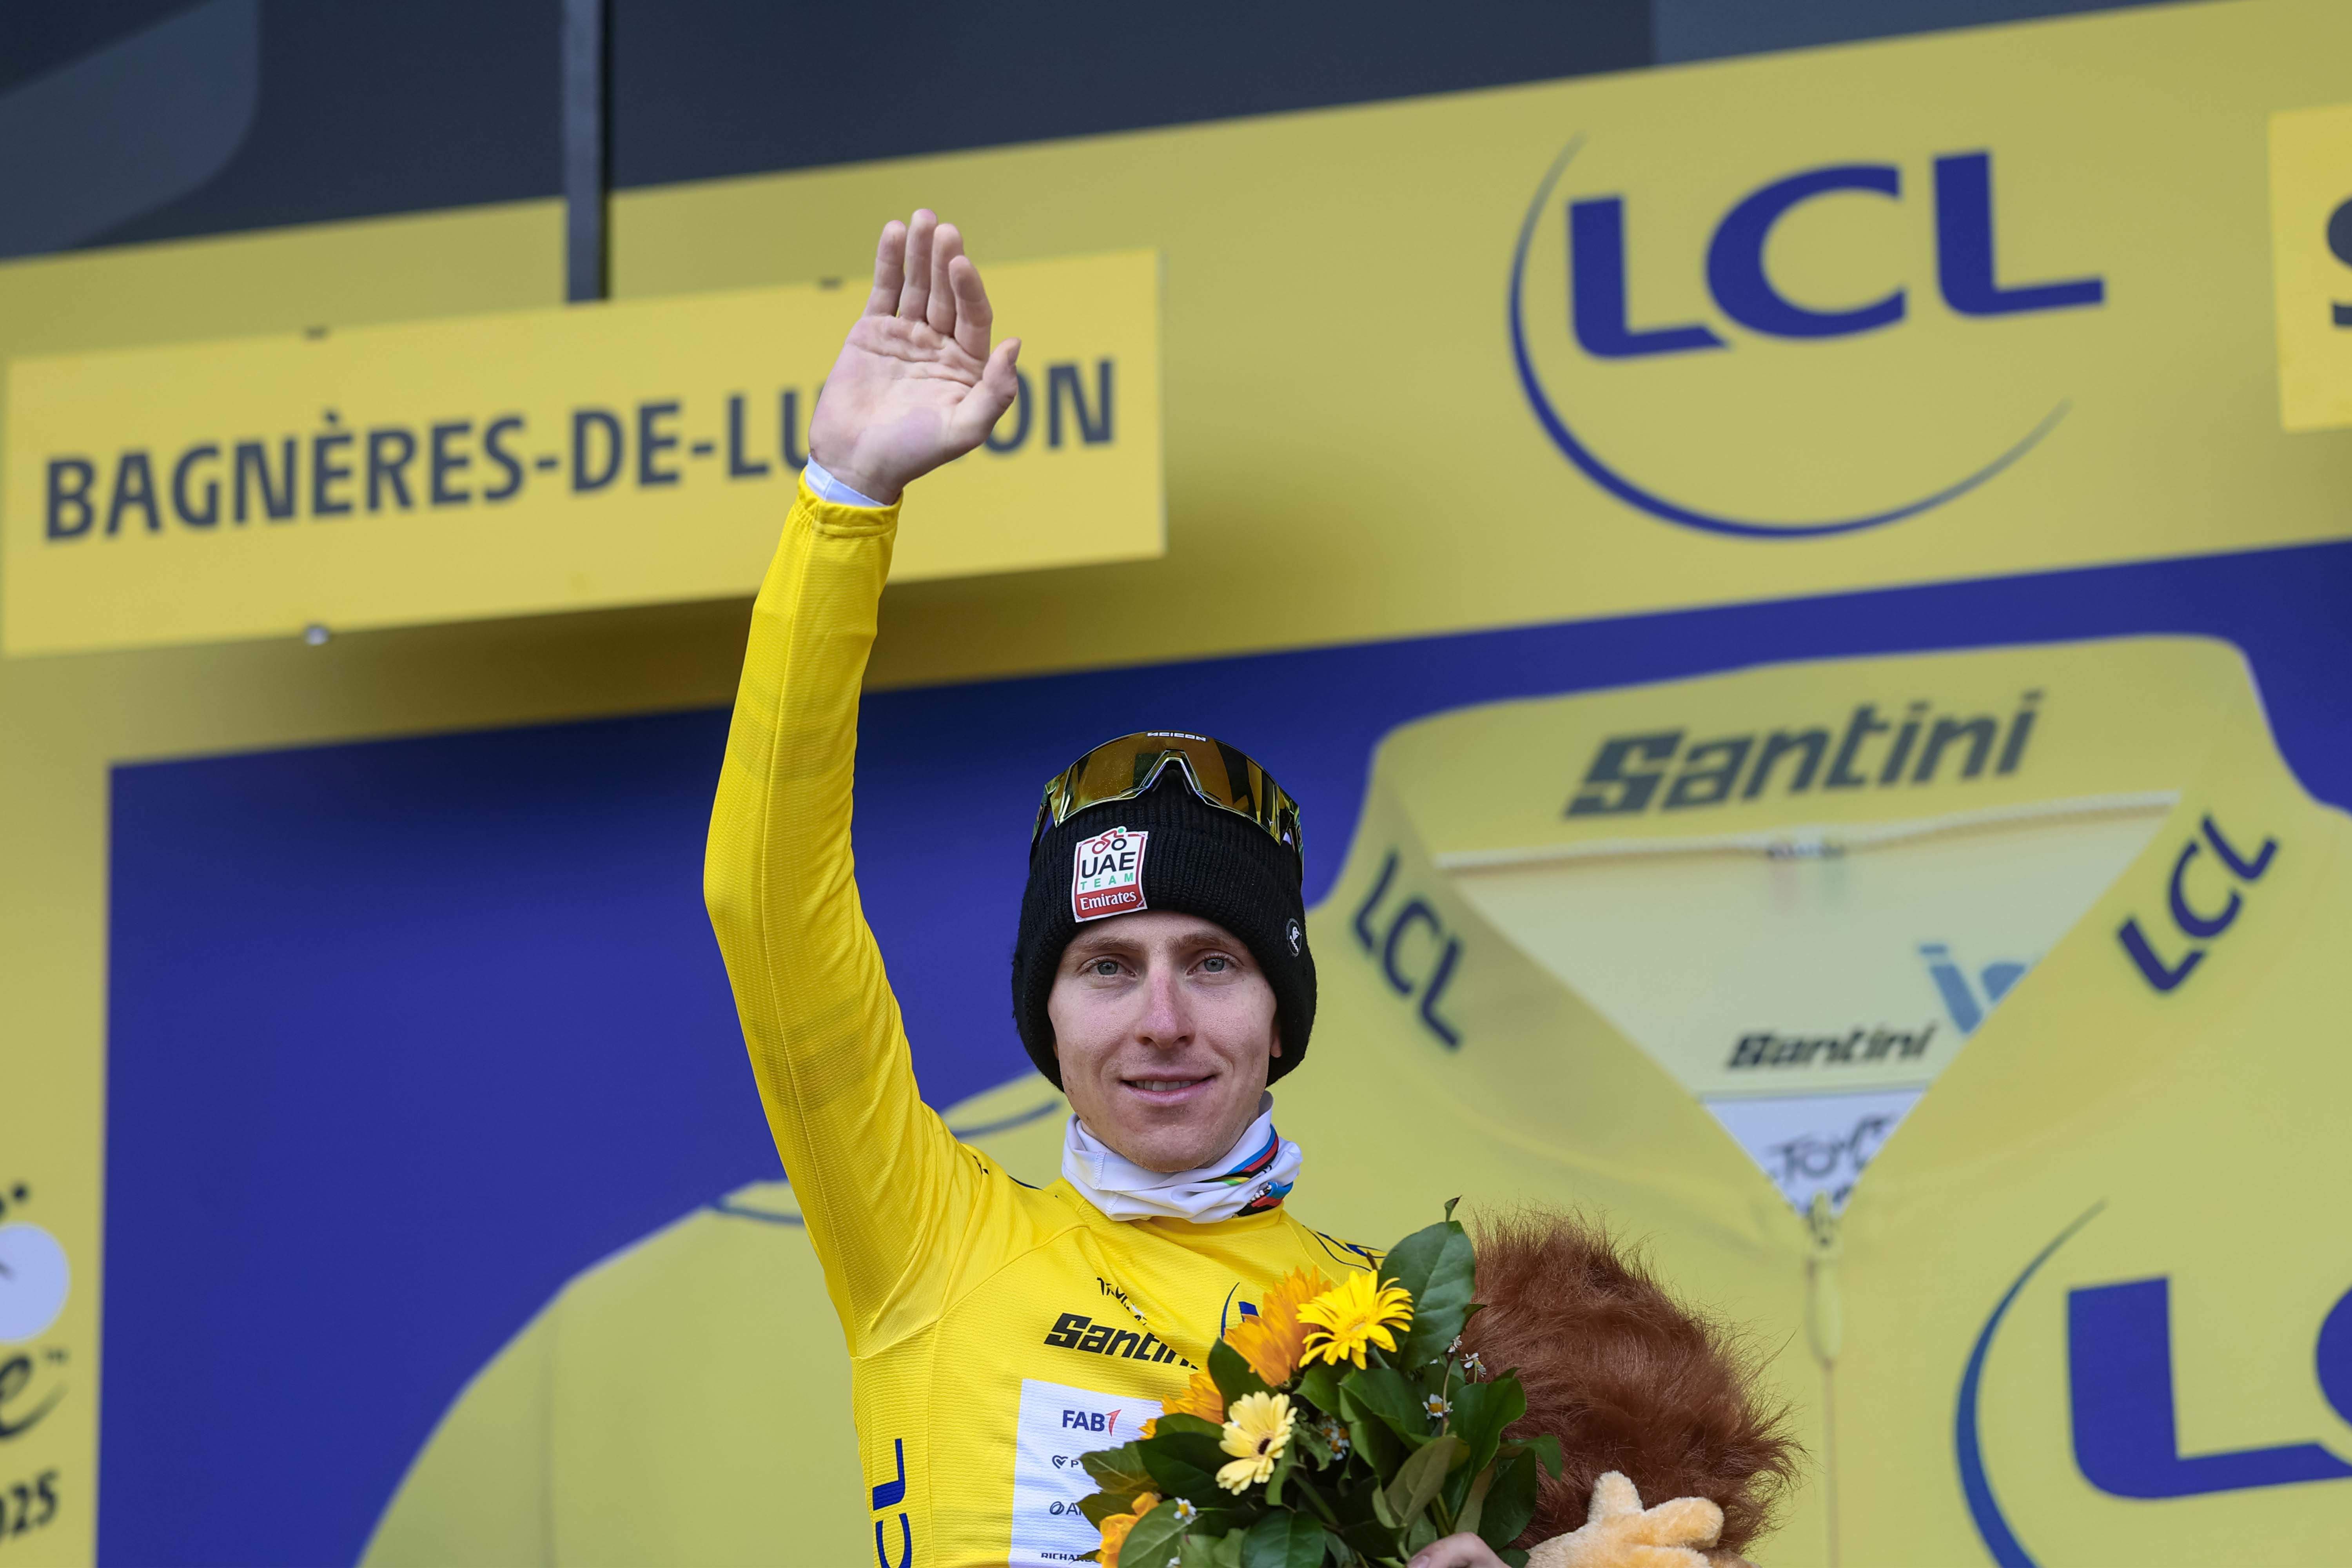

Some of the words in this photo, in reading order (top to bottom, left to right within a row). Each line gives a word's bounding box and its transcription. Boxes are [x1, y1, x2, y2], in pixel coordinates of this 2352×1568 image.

[1568, 148, 2106, 360] LCL
[1562, 689, 2045, 820] Santini
[1080, 872, 1134, 890] TEAM
[1080, 891, 1137, 910] Emirates
[1082, 851, 1136, 878] UAE
[2117, 815, 2281, 996] LCL
[1352, 850, 1463, 1052] LCL
[1725, 1020, 1938, 1070] Santini
